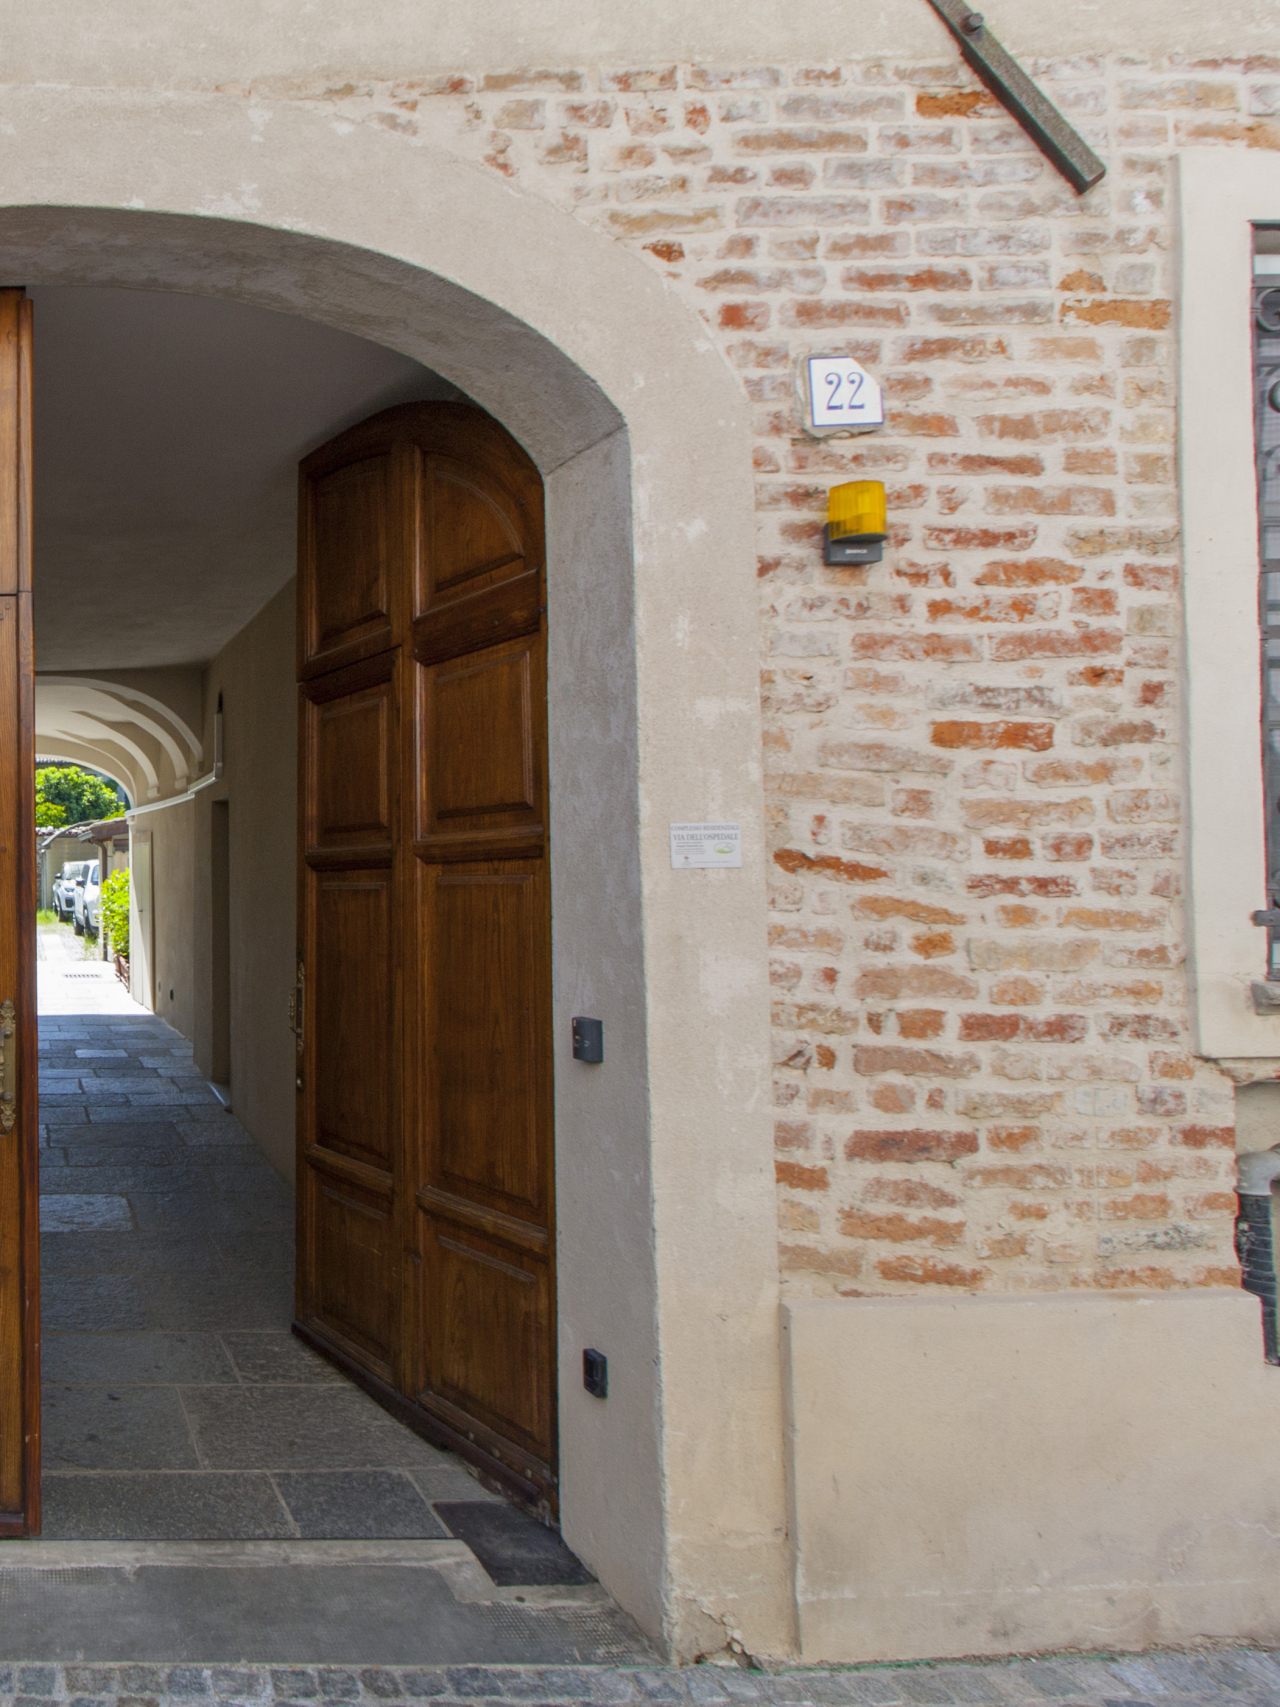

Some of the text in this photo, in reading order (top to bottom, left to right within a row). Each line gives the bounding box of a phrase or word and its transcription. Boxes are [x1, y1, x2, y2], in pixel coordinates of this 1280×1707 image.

[825, 372, 865, 410] 22
[673, 833, 739, 841] VIA DELL'OSPEDALE
